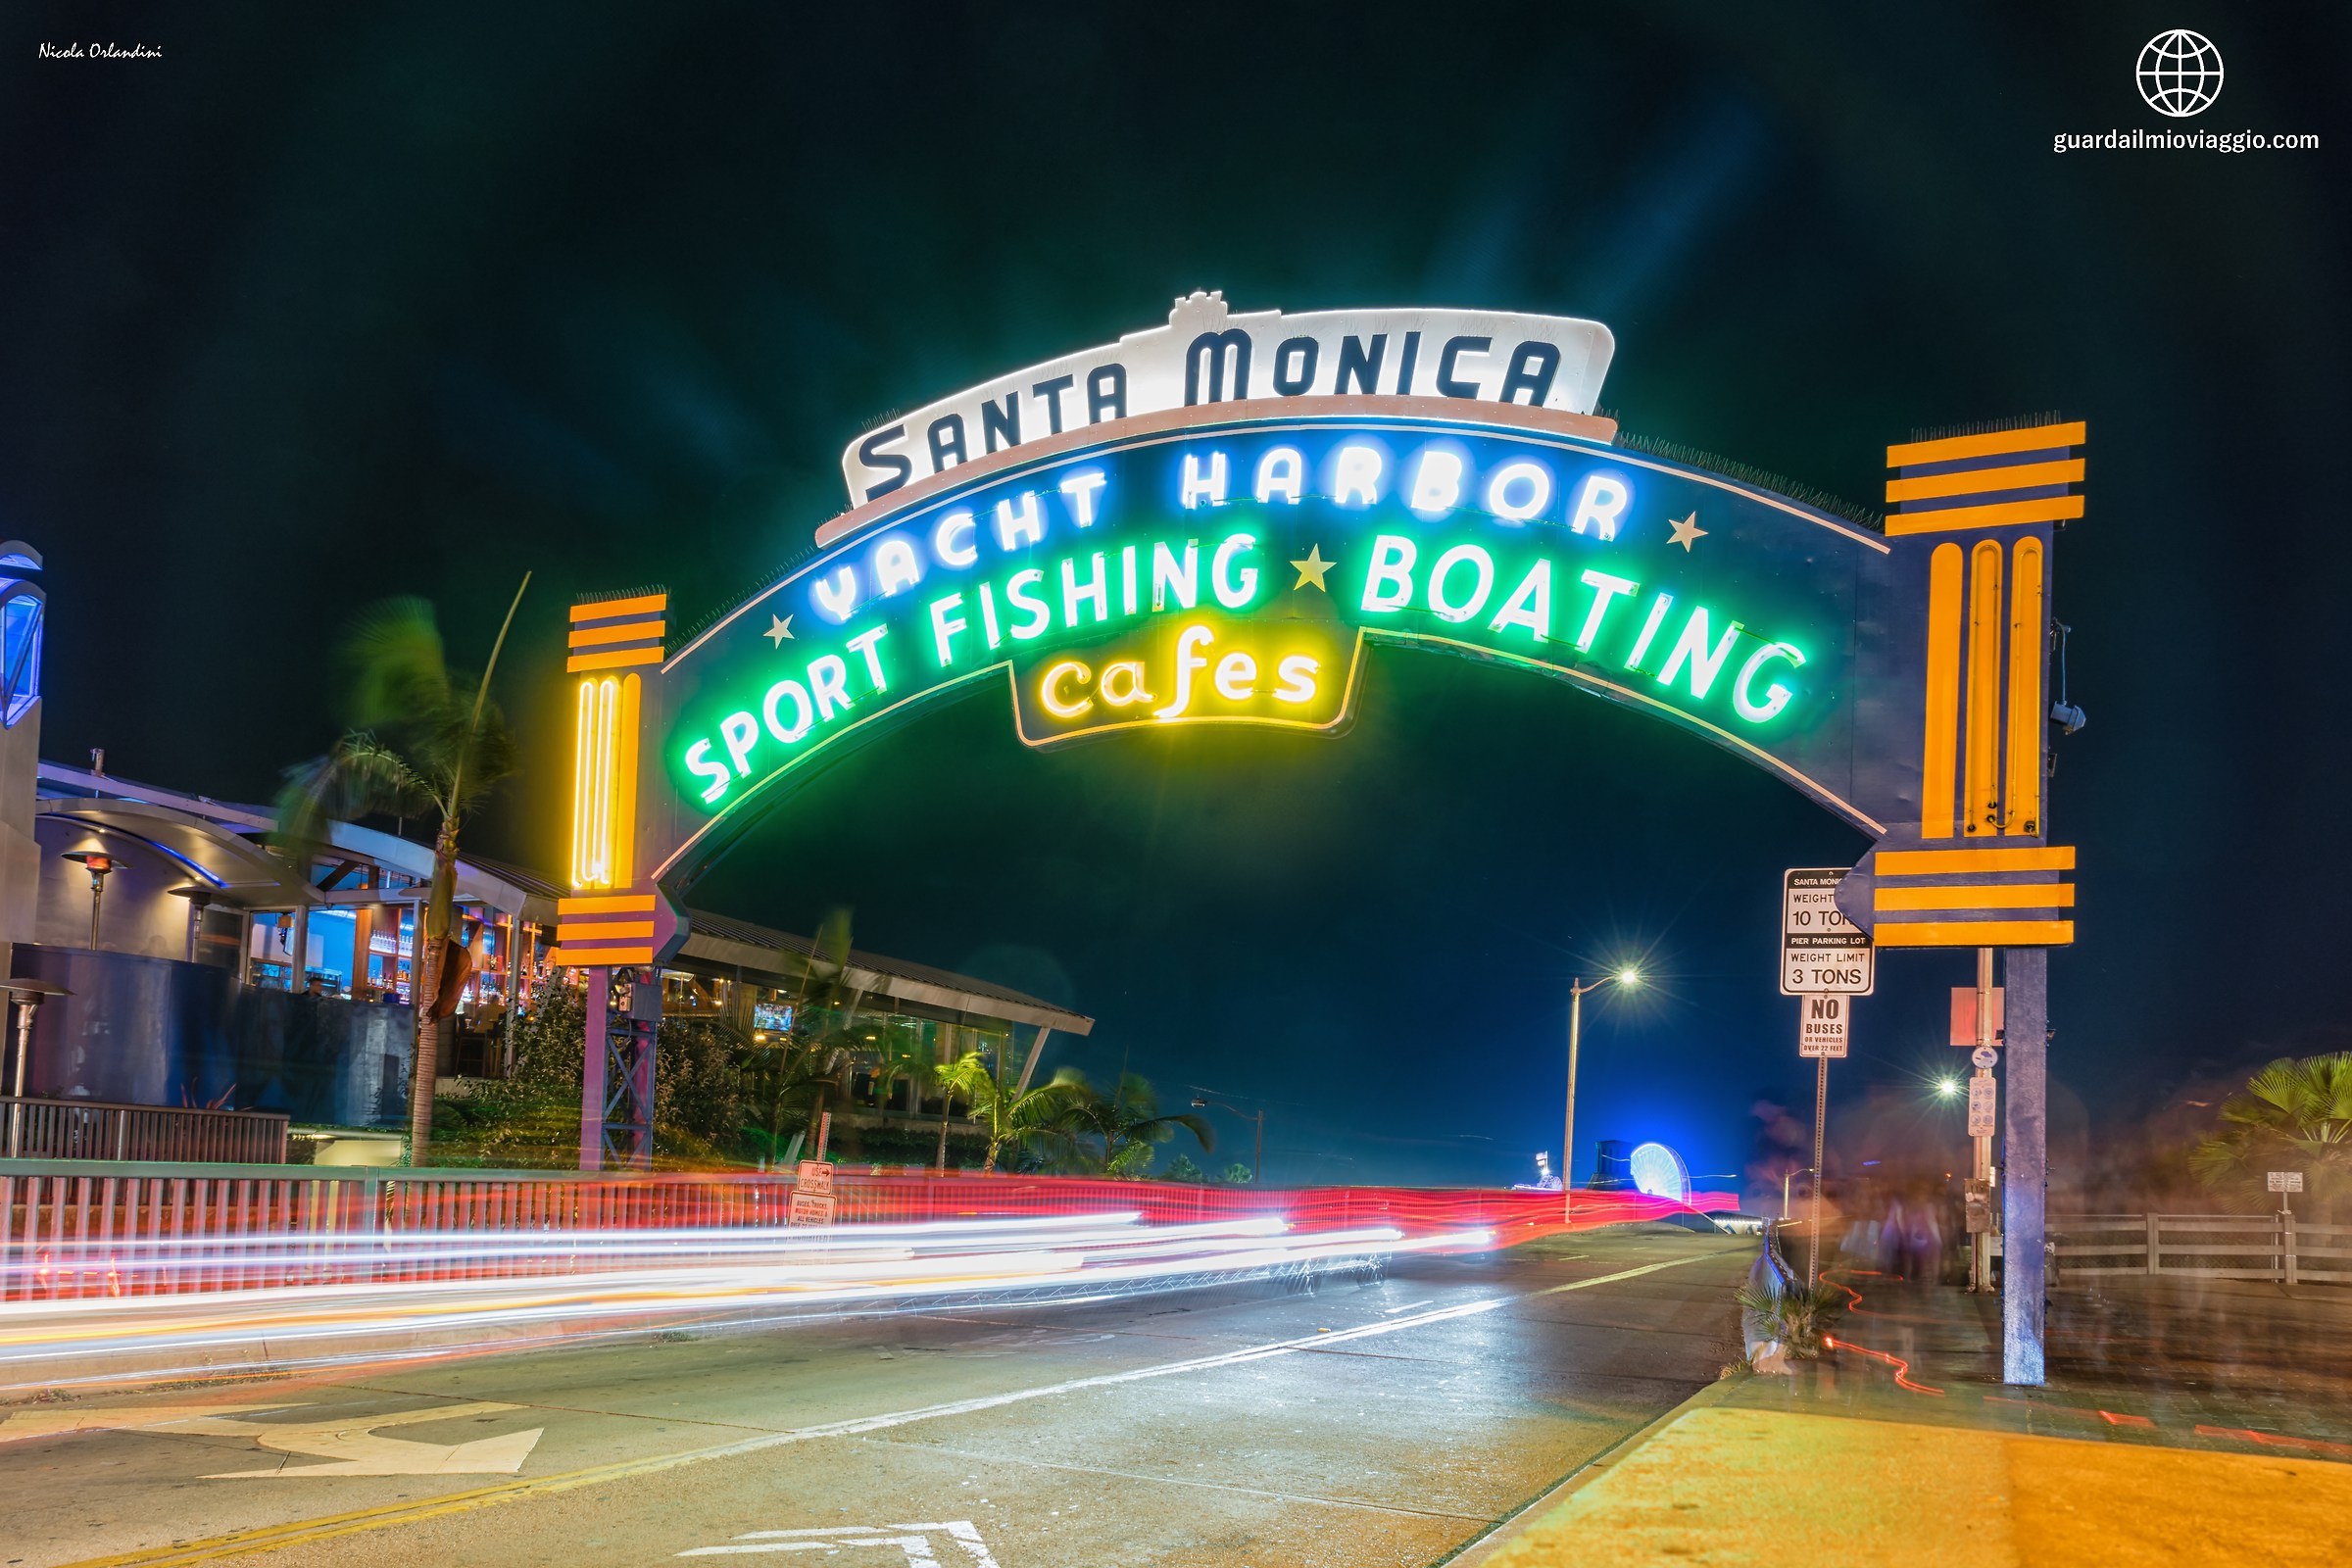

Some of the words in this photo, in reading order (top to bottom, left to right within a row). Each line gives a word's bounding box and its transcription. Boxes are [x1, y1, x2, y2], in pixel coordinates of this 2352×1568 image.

[858, 363, 1127, 502] SANTA
[1183, 328, 1561, 407] MONICA
[813, 472, 1106, 620] YACHT
[1180, 446, 1628, 542] HARBOR
[685, 623, 889, 805] SPORT
[928, 533, 1259, 667] FISHING
[1360, 534, 1807, 723] BOATING
[1040, 624, 1323, 719] cafes
[1793, 894, 1835, 903] WEIGHT
[1792, 910, 1811, 926] 10
[1790, 953, 1832, 962] WEIGHT
[1837, 953, 1865, 962] LIMIT
[1791, 968, 1803, 984] 3
[1811, 968, 1862, 984] TONS
[1811, 999, 1839, 1019] NO
[1805, 1023, 1842, 1034] BUSES
[811, 1167, 822, 1177] USE
[800, 1178, 829, 1190] CROSSWALK
[806, 1216, 824, 1225] VEHICLES
